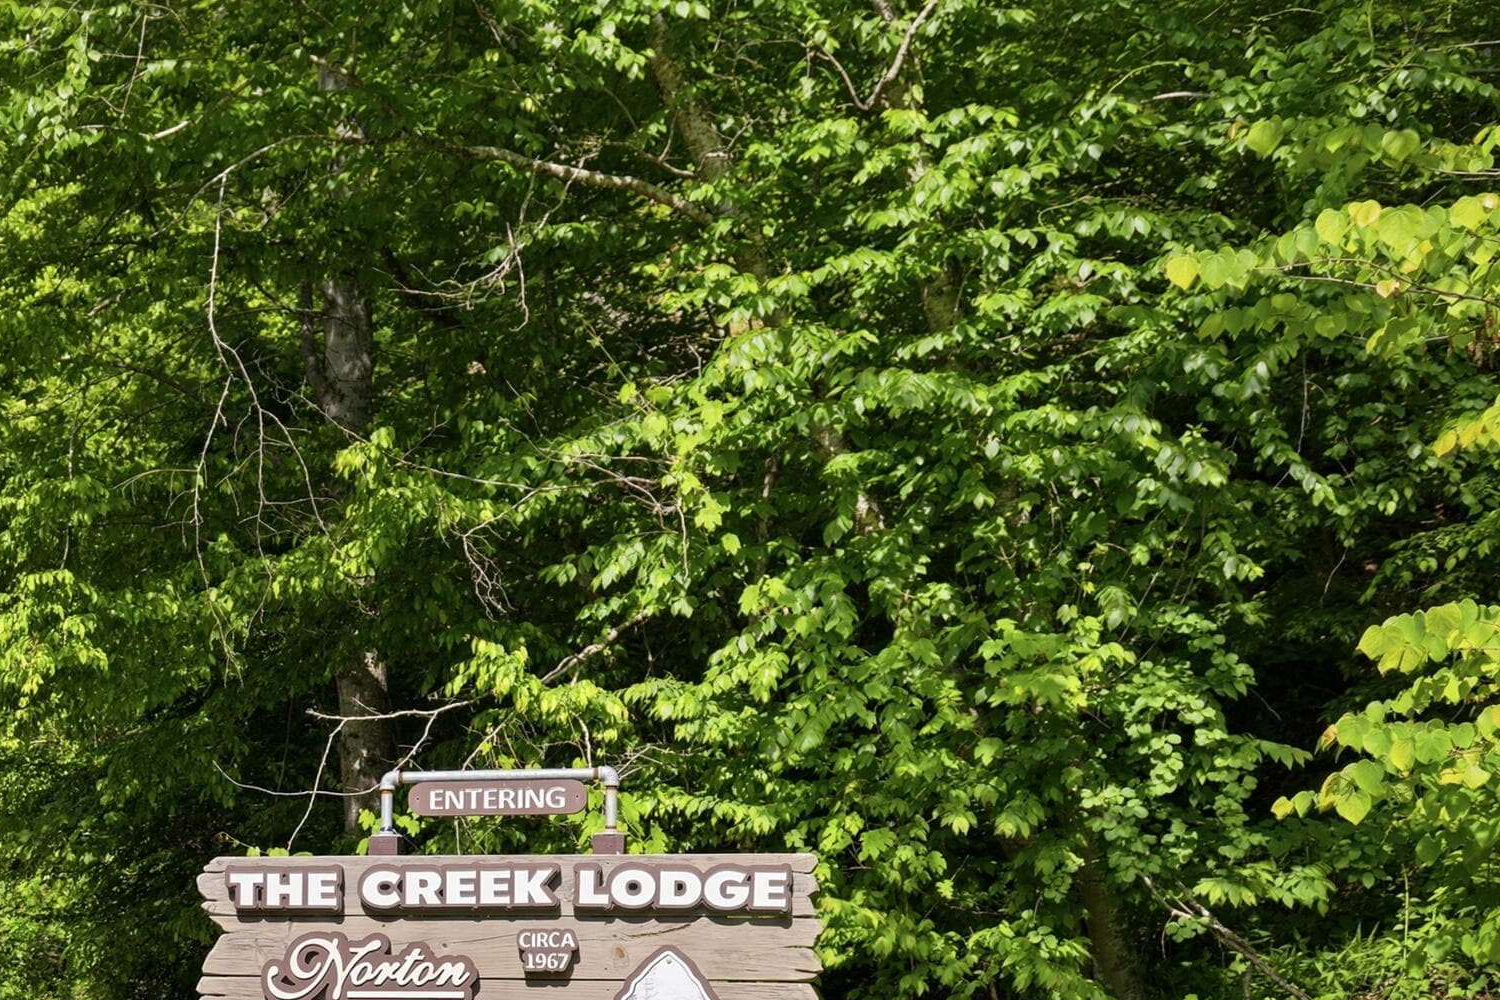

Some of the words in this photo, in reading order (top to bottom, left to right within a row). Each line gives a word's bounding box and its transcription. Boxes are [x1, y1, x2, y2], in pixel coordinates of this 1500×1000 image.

[429, 787, 566, 810] ENTERING
[229, 872, 338, 907] THE
[363, 870, 552, 907] CREEK
[579, 870, 789, 908] LODGE
[519, 932, 575, 950] CIRCA
[267, 938, 469, 999] Norton
[526, 952, 569, 971] 1967
